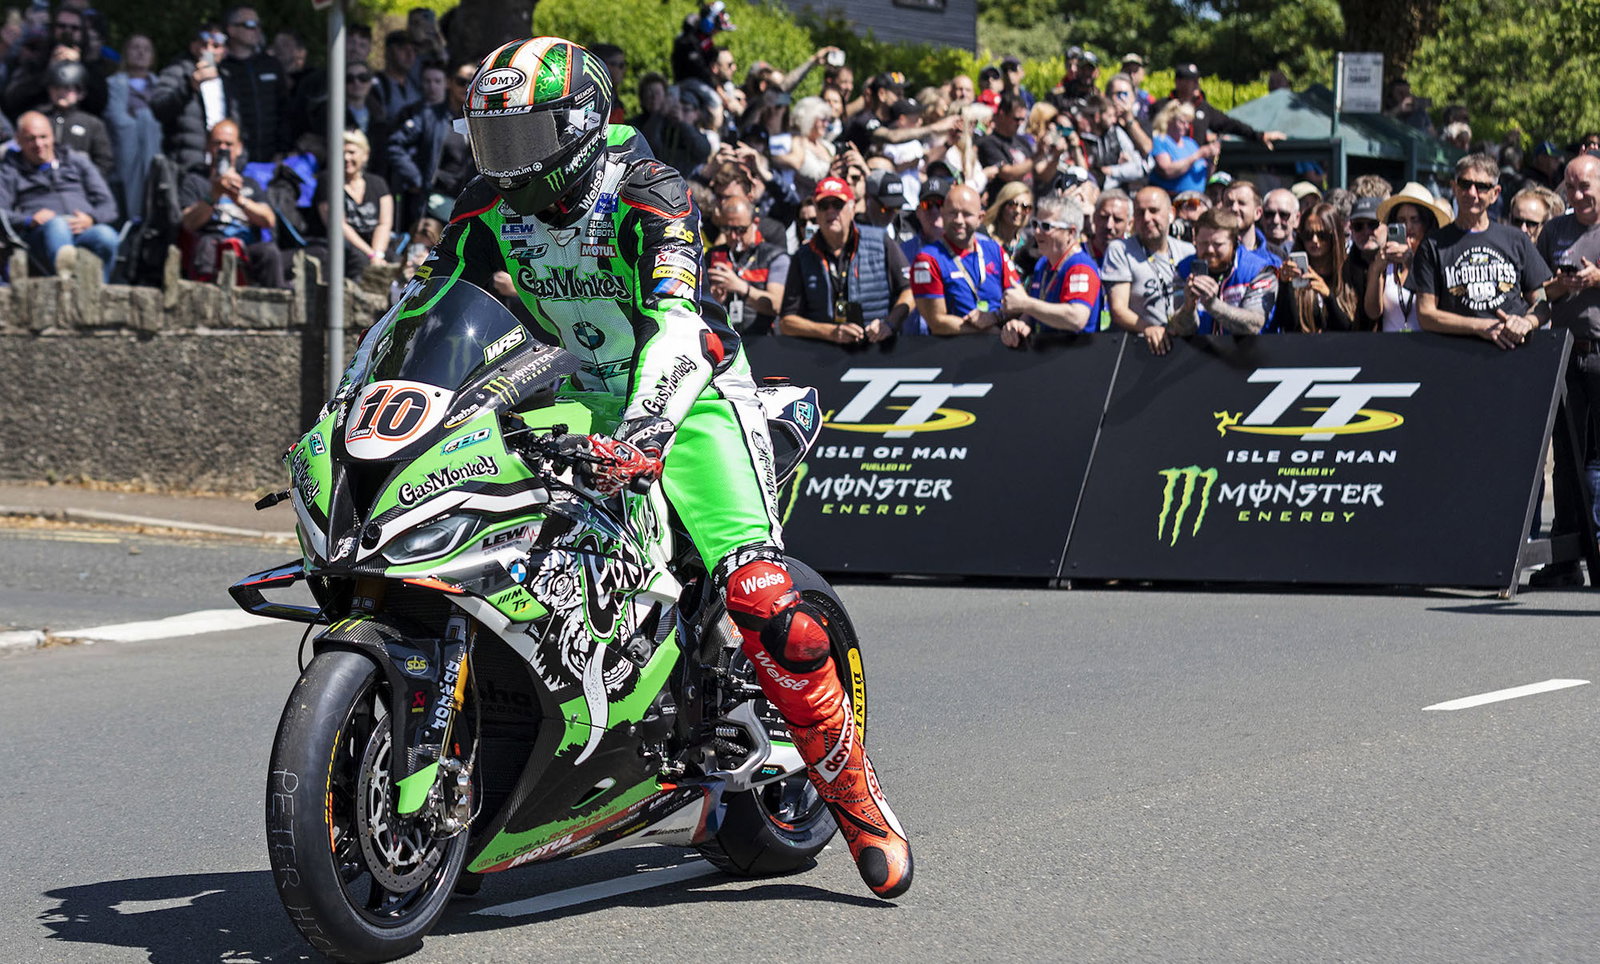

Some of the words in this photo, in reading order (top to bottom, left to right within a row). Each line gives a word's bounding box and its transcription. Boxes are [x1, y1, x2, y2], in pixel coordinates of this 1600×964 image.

[479, 76, 519, 88] SUOMY
[579, 169, 604, 210] Weise
[501, 223, 534, 234] LEW
[662, 222, 695, 244] sbs
[582, 245, 616, 257] MOTUL
[517, 266, 632, 300] GasMonkey
[486, 327, 524, 362] WRS
[642, 356, 698, 417] GasMonkey
[346, 384, 431, 443] 10
[833, 367, 993, 439] TT
[1242, 366, 1421, 442] TT
[815, 446, 865, 460] ISLE
[873, 446, 905, 460] OF
[911, 446, 968, 460] MAN
[1226, 450, 1281, 463] ISLE
[1290, 450, 1325, 463] OF
[1335, 450, 1397, 463] MAN
[860, 463, 899, 472] FUELLED
[899, 463, 912, 472] BY
[1277, 467, 1320, 476] FUELLED
[1321, 467, 1336, 476] BY
[397, 455, 499, 507] GasMonkey
[806, 473, 953, 501] MONSTER
[1217, 479, 1384, 508] MONSTER
[821, 503, 926, 516] ENERGY
[1237, 510, 1355, 523] ENERGY
[482, 525, 528, 548] LEW
[740, 572, 786, 595] Weise
[406, 655, 427, 671] sbs
[754, 650, 809, 691] Weise
[272, 768, 301, 889] PETER
[507, 833, 576, 870] MOTUL
